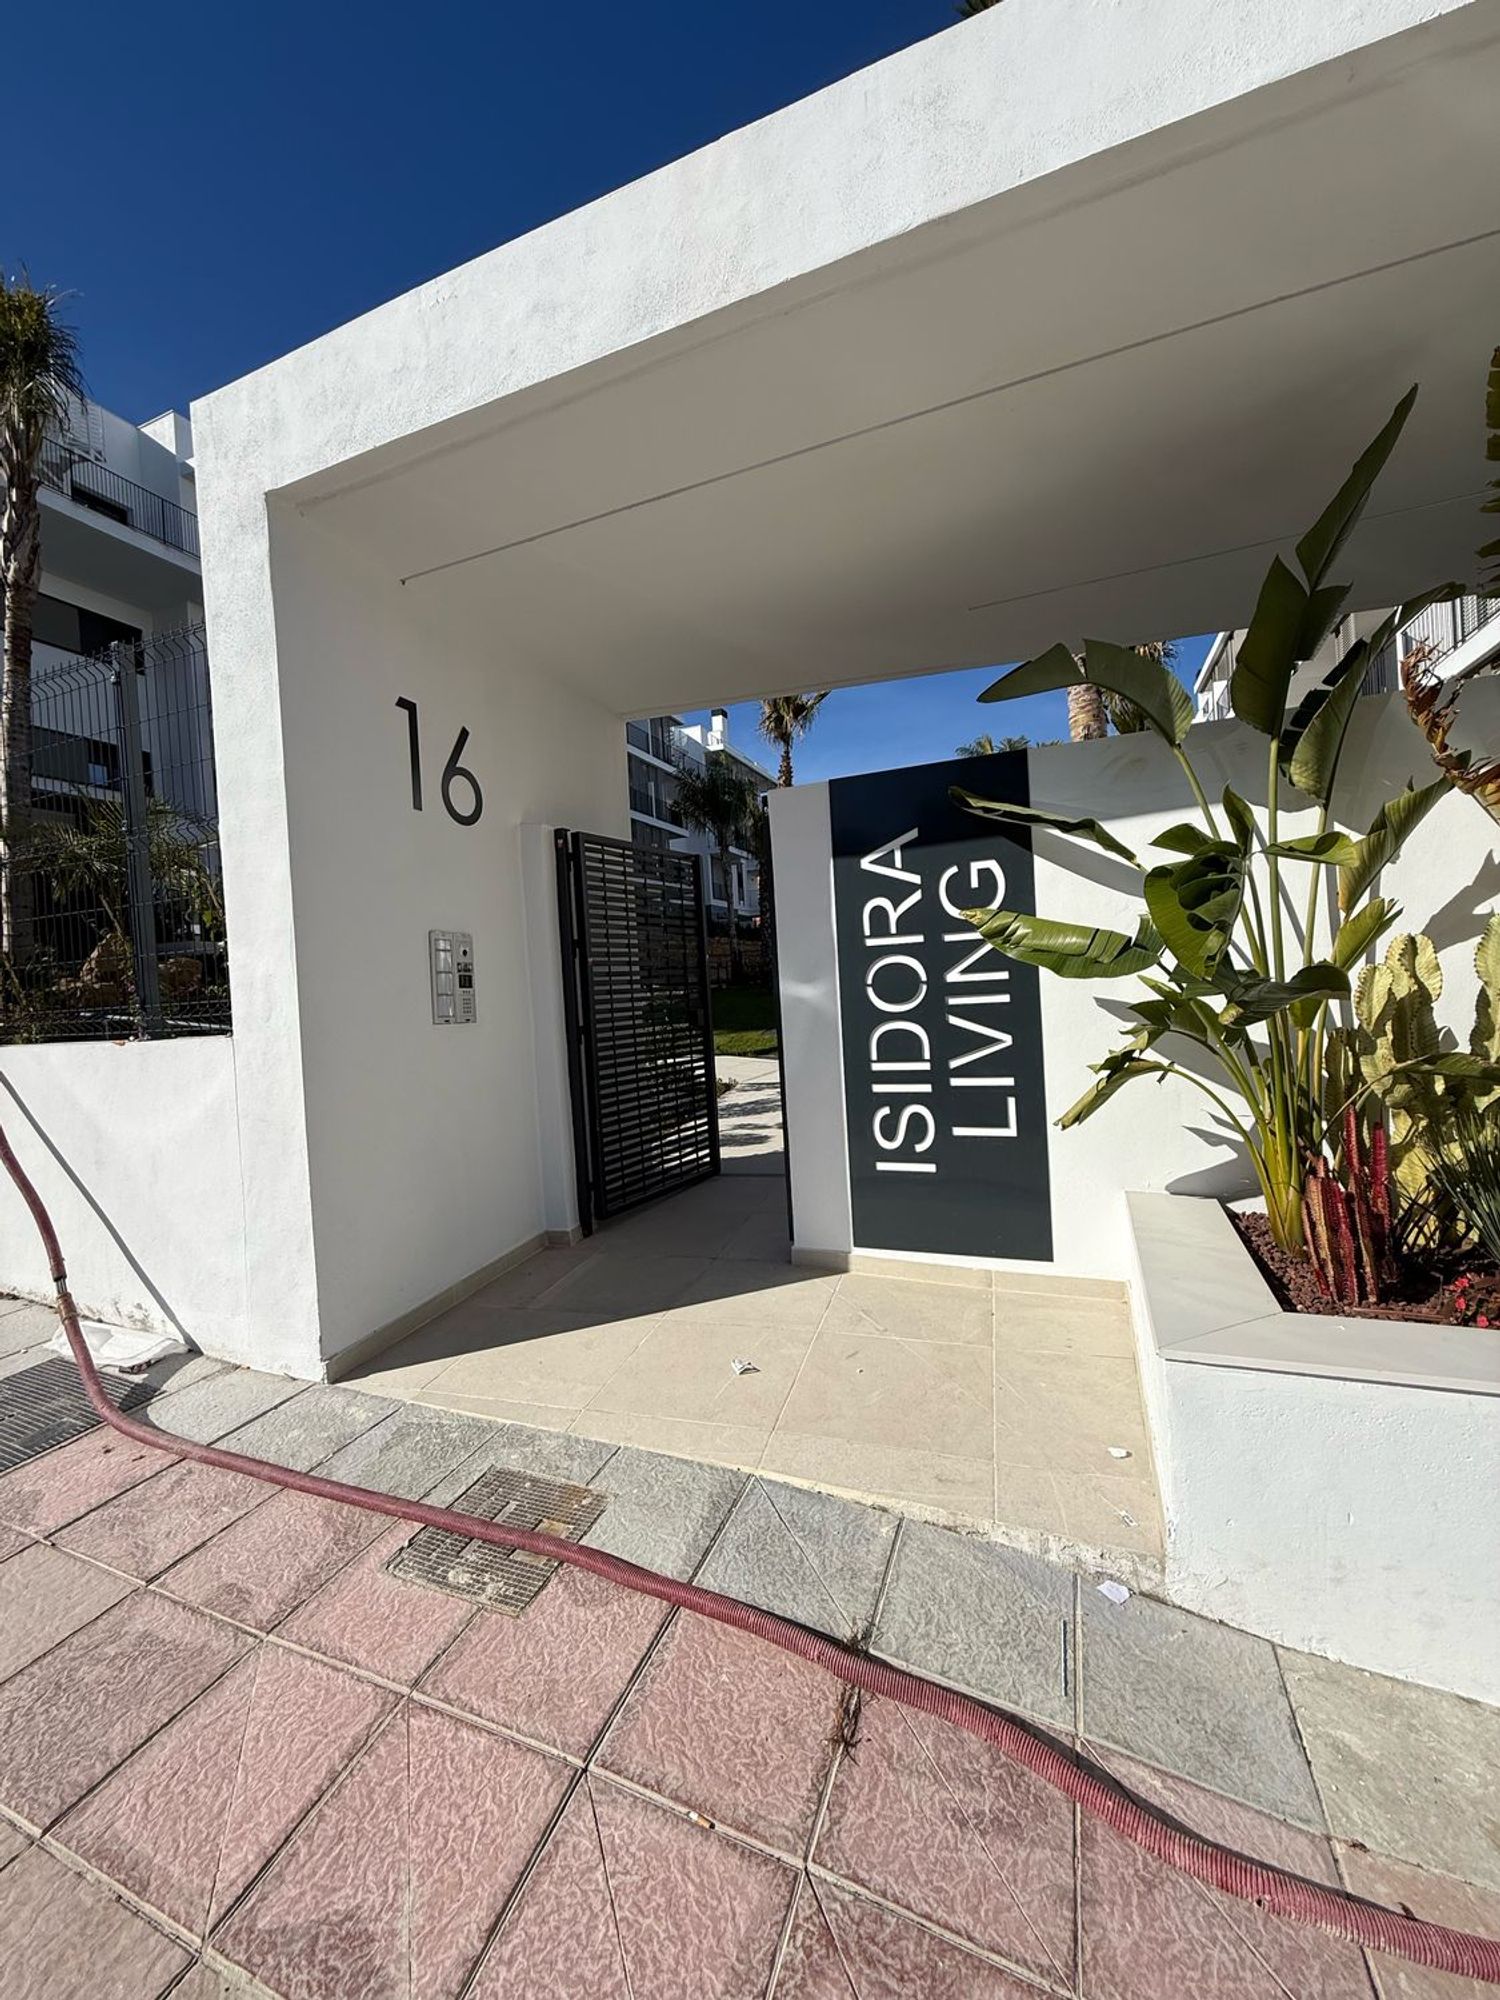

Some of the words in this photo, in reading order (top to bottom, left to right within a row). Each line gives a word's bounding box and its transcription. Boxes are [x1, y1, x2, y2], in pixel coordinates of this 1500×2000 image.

[395, 696, 483, 826] 16
[860, 826, 938, 1174] ISIDORA
[938, 858, 1018, 1139] LIVING
